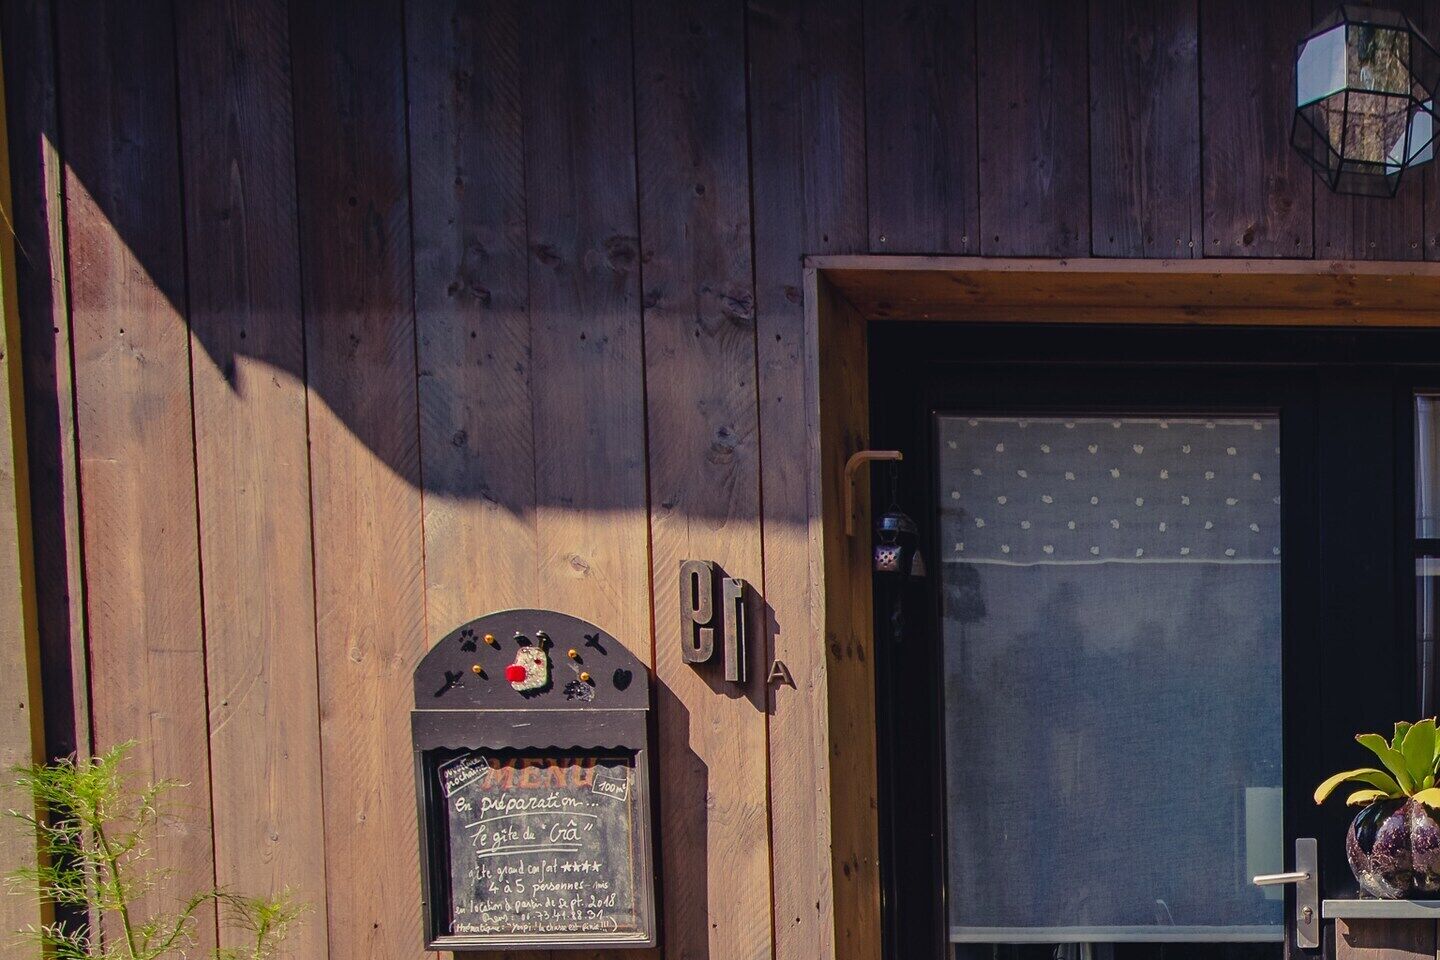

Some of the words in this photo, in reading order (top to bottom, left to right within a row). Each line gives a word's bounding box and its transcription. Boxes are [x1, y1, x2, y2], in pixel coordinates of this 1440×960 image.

[482, 757, 597, 790] MENU
[488, 882, 499, 894] 4
[515, 879, 525, 893] 5
[588, 892, 617, 908] 2018
